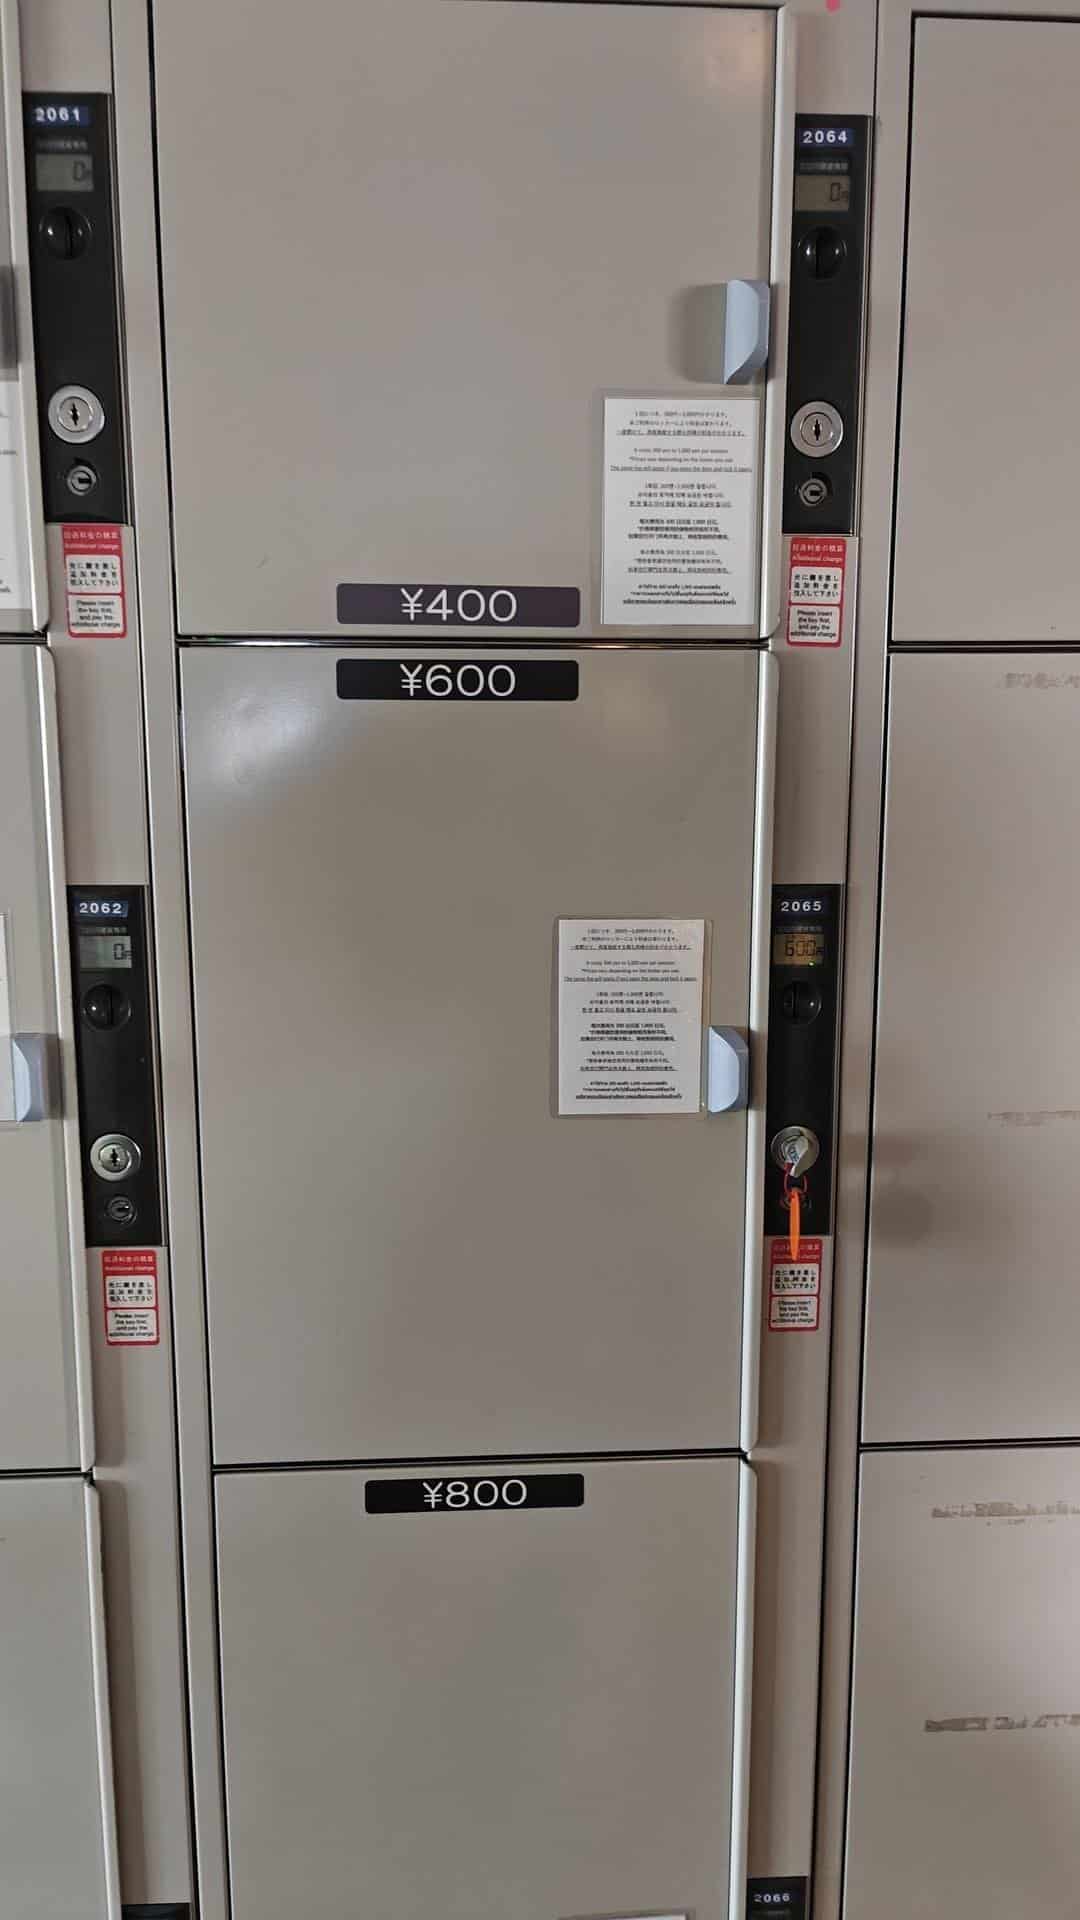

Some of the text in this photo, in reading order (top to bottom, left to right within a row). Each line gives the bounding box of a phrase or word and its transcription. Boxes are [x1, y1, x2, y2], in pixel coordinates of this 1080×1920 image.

[35, 107, 81, 122] 2061
[803, 130, 847, 144] 2064
[400, 588, 518, 622] ¥400
[400, 664, 516, 697] ¥600
[79, 902, 122, 913] 2062
[781, 901, 822, 912] 2065
[423, 1479, 527, 1509] ¥800
[754, 1893, 790, 1903] 2066
